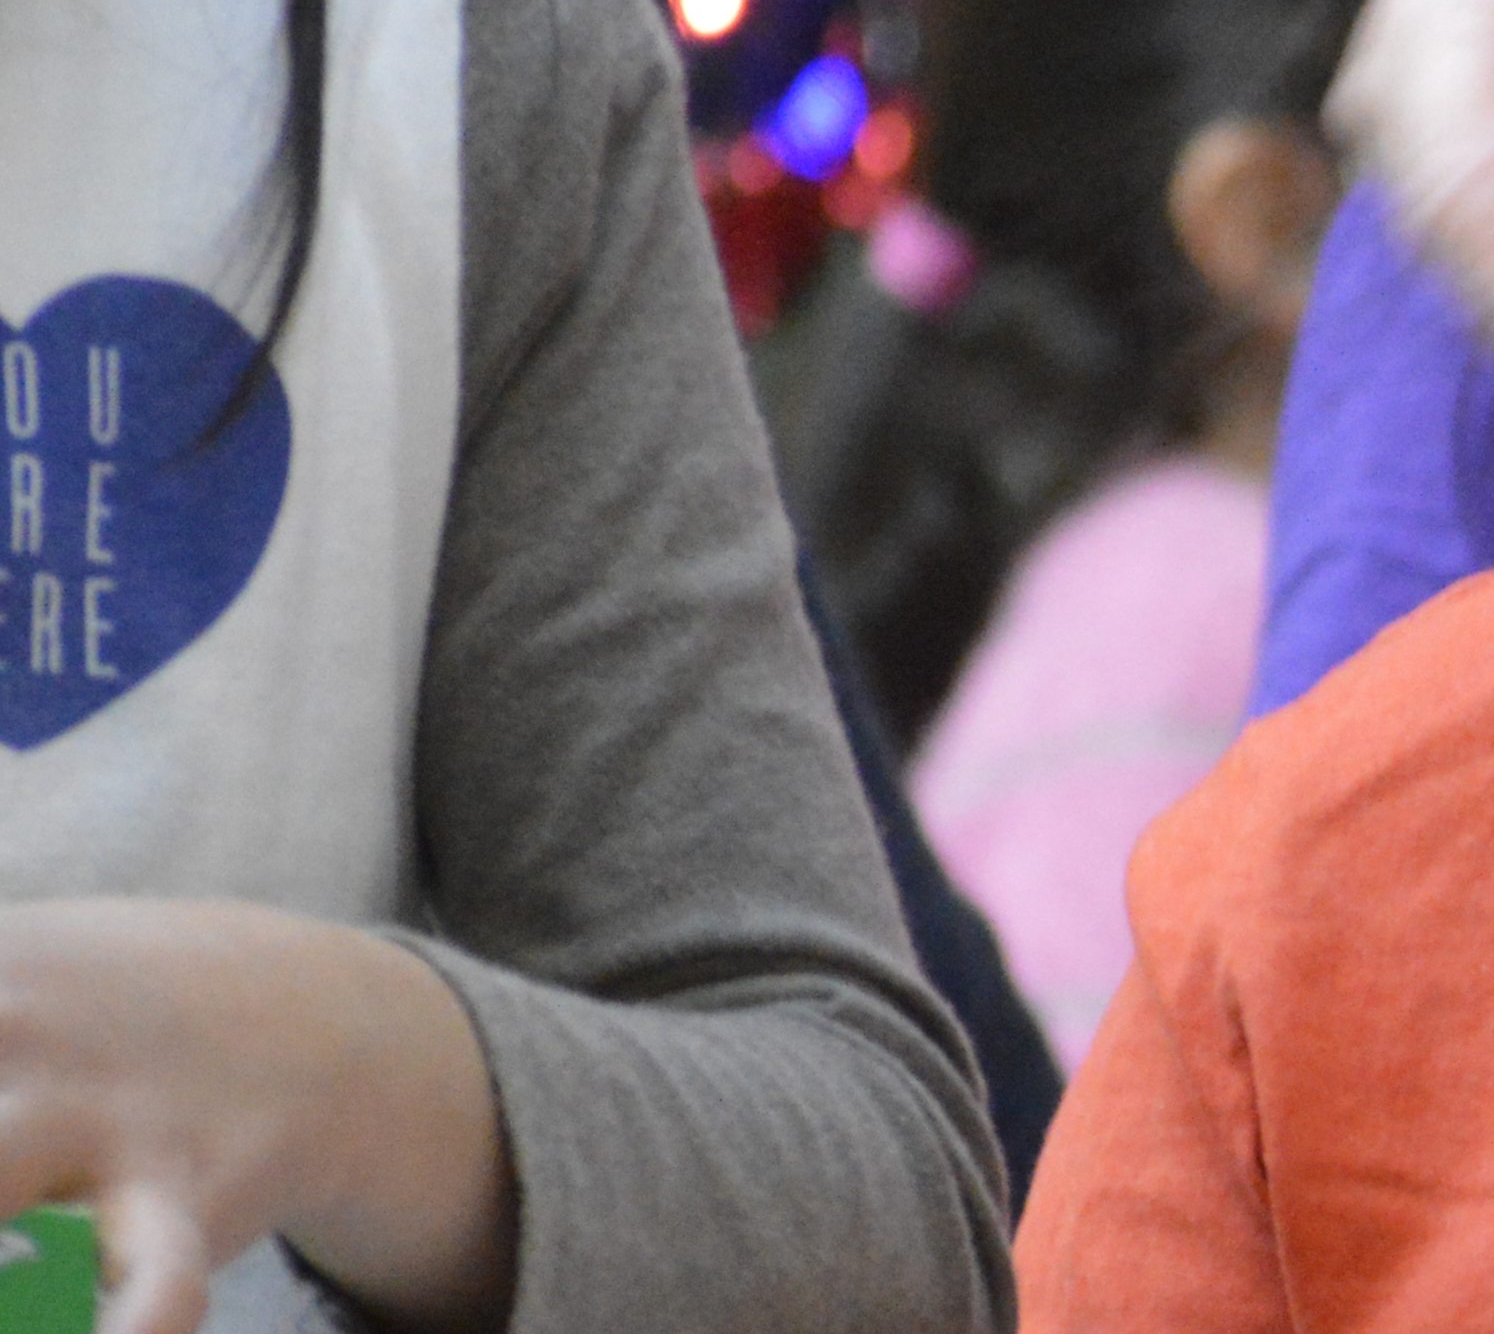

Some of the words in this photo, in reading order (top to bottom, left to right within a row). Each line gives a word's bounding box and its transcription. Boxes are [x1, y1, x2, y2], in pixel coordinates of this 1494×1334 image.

[4, 341, 121, 445] OU
[9, 453, 116, 564] RE
[0, 571, 119, 679] RE
